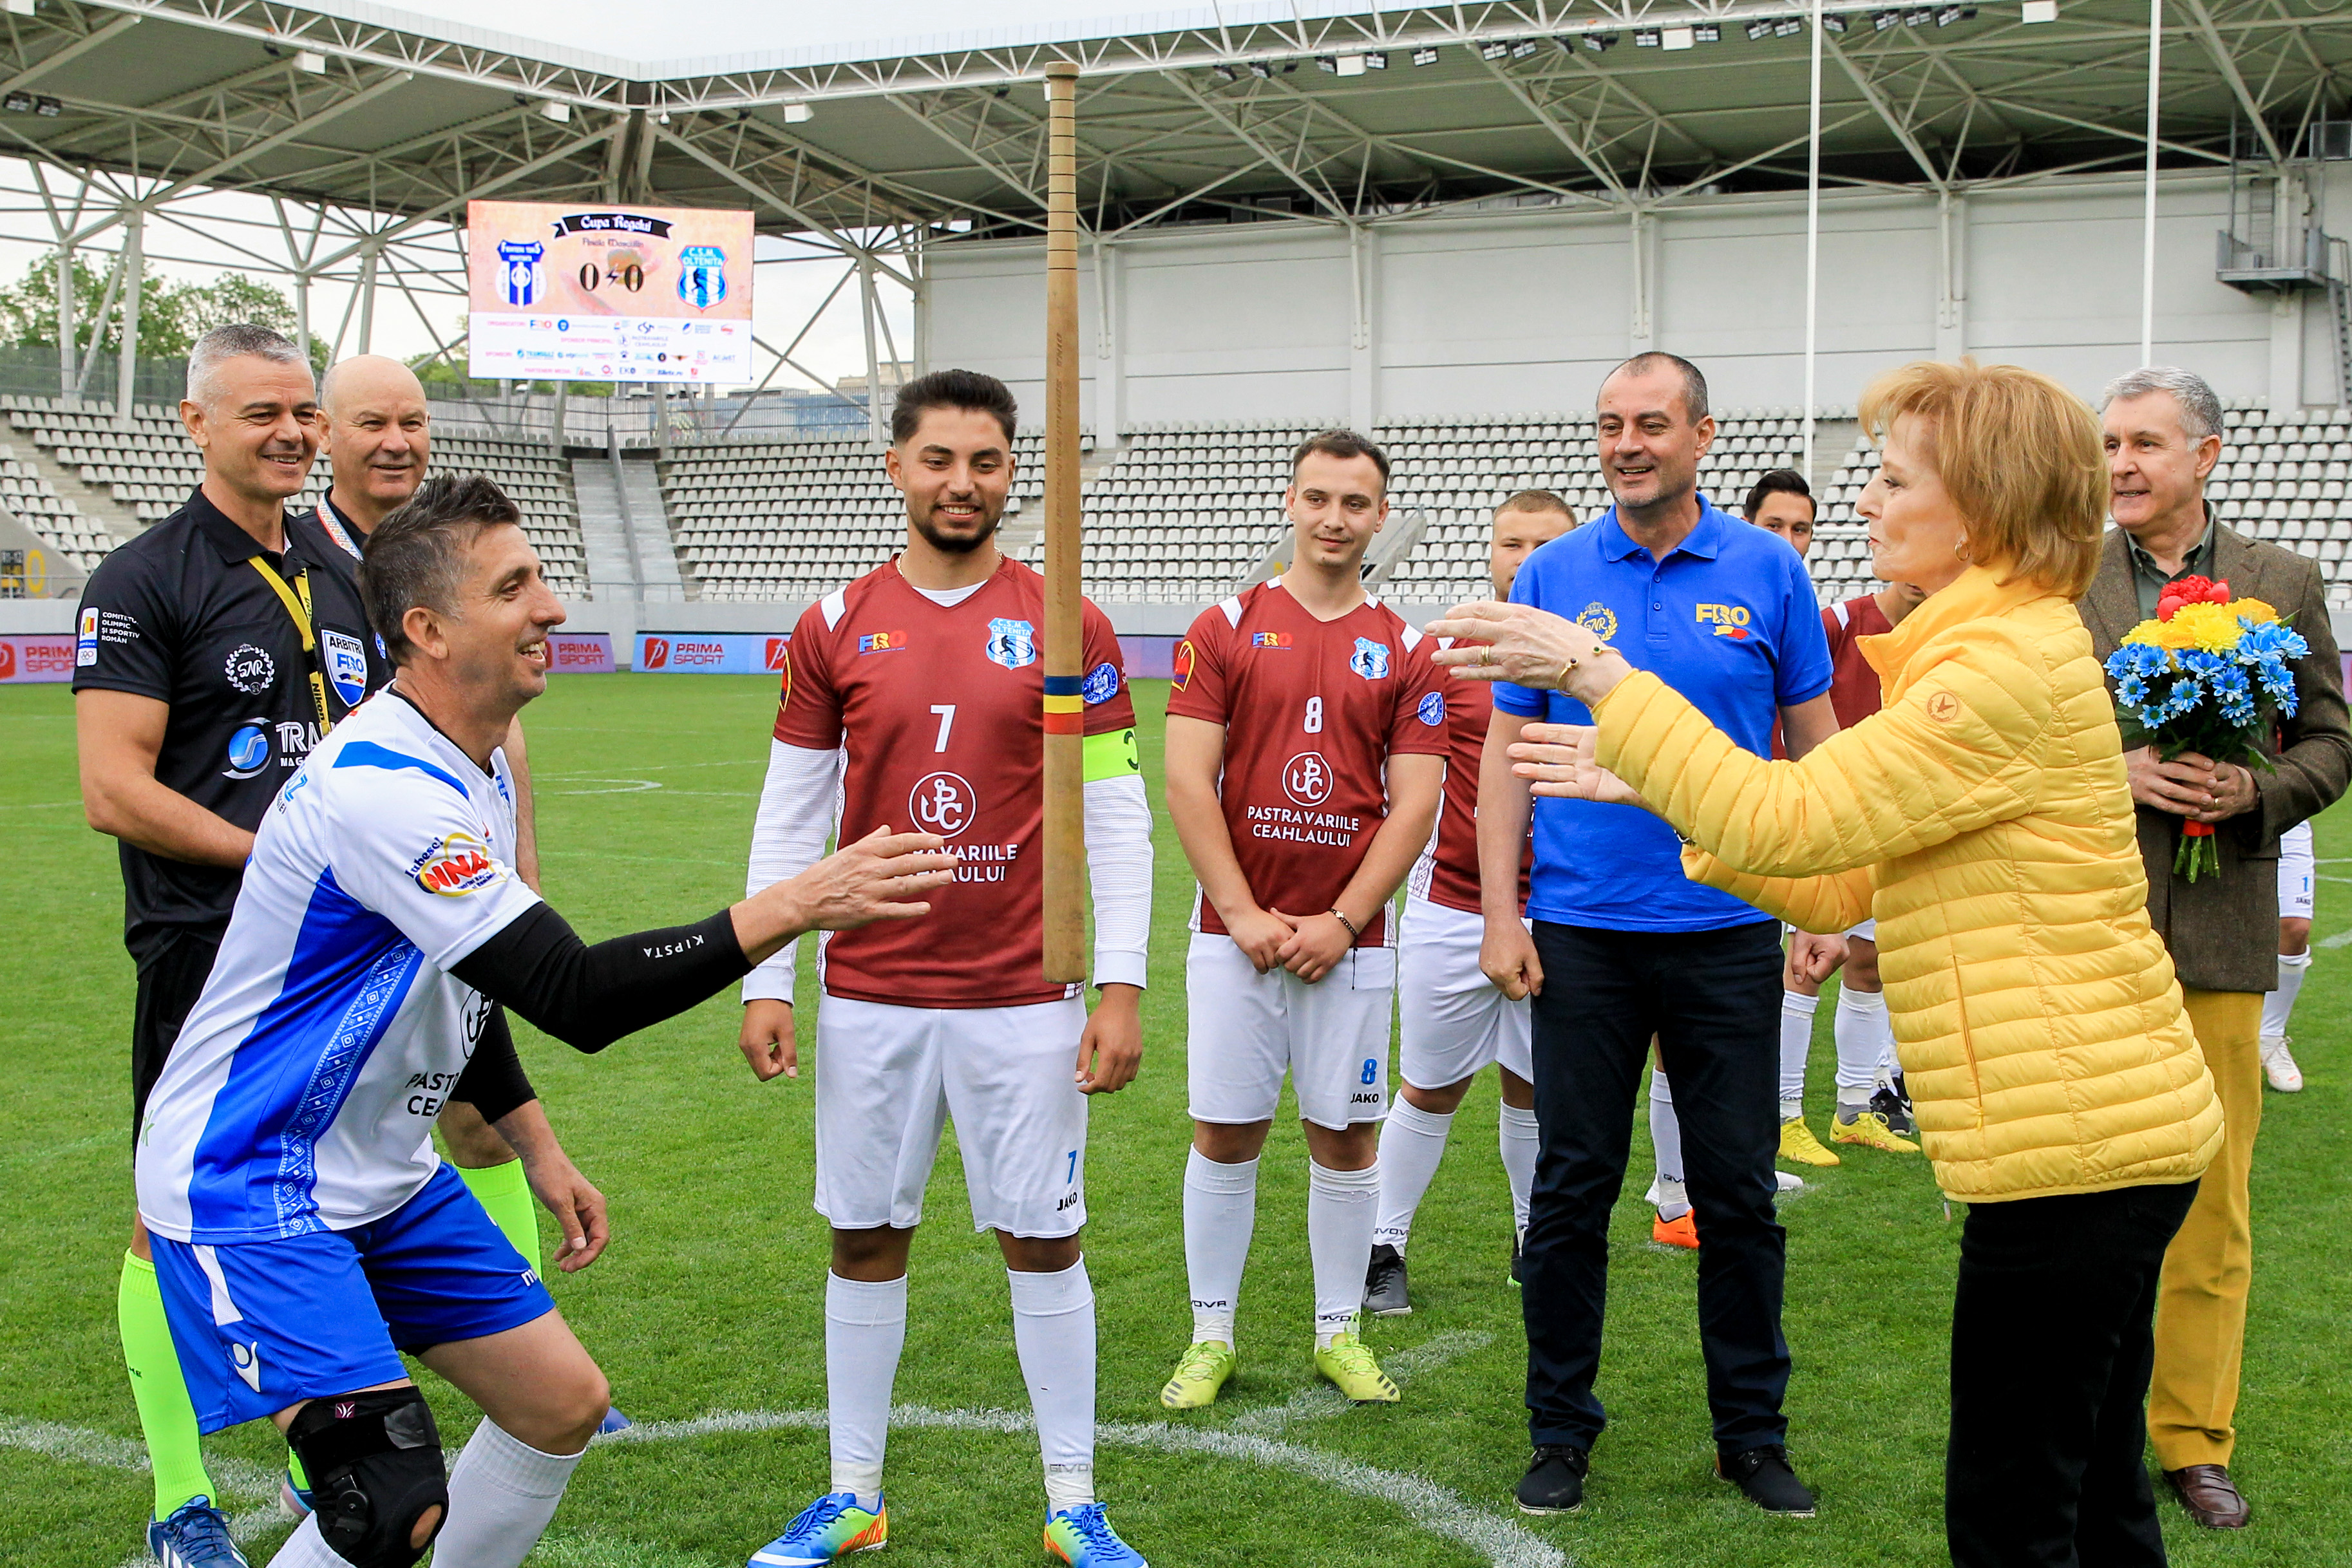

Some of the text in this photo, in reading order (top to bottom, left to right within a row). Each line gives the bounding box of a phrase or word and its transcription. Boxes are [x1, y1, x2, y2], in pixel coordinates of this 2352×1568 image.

[581, 216, 610, 230] Cupa
[580, 263, 599, 292] 0
[624, 264, 643, 292] 0
[101, 619, 131, 629] OLIMPIC
[998, 619, 1024, 629] C.S.M.
[1696, 603, 1750, 626] FRO
[101, 635, 128, 644] ROMÂN
[109, 629, 140, 638] SPORTIV
[859, 630, 907, 652] FRO
[1253, 632, 1293, 647] FRO
[26, 647, 75, 657] PRIM
[329, 636, 363, 656] ARBITRI
[558, 643, 602, 653] PRIMA
[676, 643, 723, 654] PRIMA
[336, 653, 365, 672] FRO
[558, 654, 605, 665] SPORT
[674, 654, 725, 665] SPORT
[312, 683, 325, 721] Nikon
[1304, 696, 1323, 733] 8
[930, 704, 956, 753] 7
[1247, 806, 1359, 831] PASTRAVARIILE
[1253, 824, 1351, 847] CEAHLAULUI
[404, 837, 444, 879] Iubesc!
[2302, 876, 2308, 892] 1
[643, 934, 705, 958] KIPSTA
[1361, 1059, 1377, 1084] 8
[1351, 1093, 1379, 1103] JAKO
[1057, 1192, 1077, 1211] JAKO
